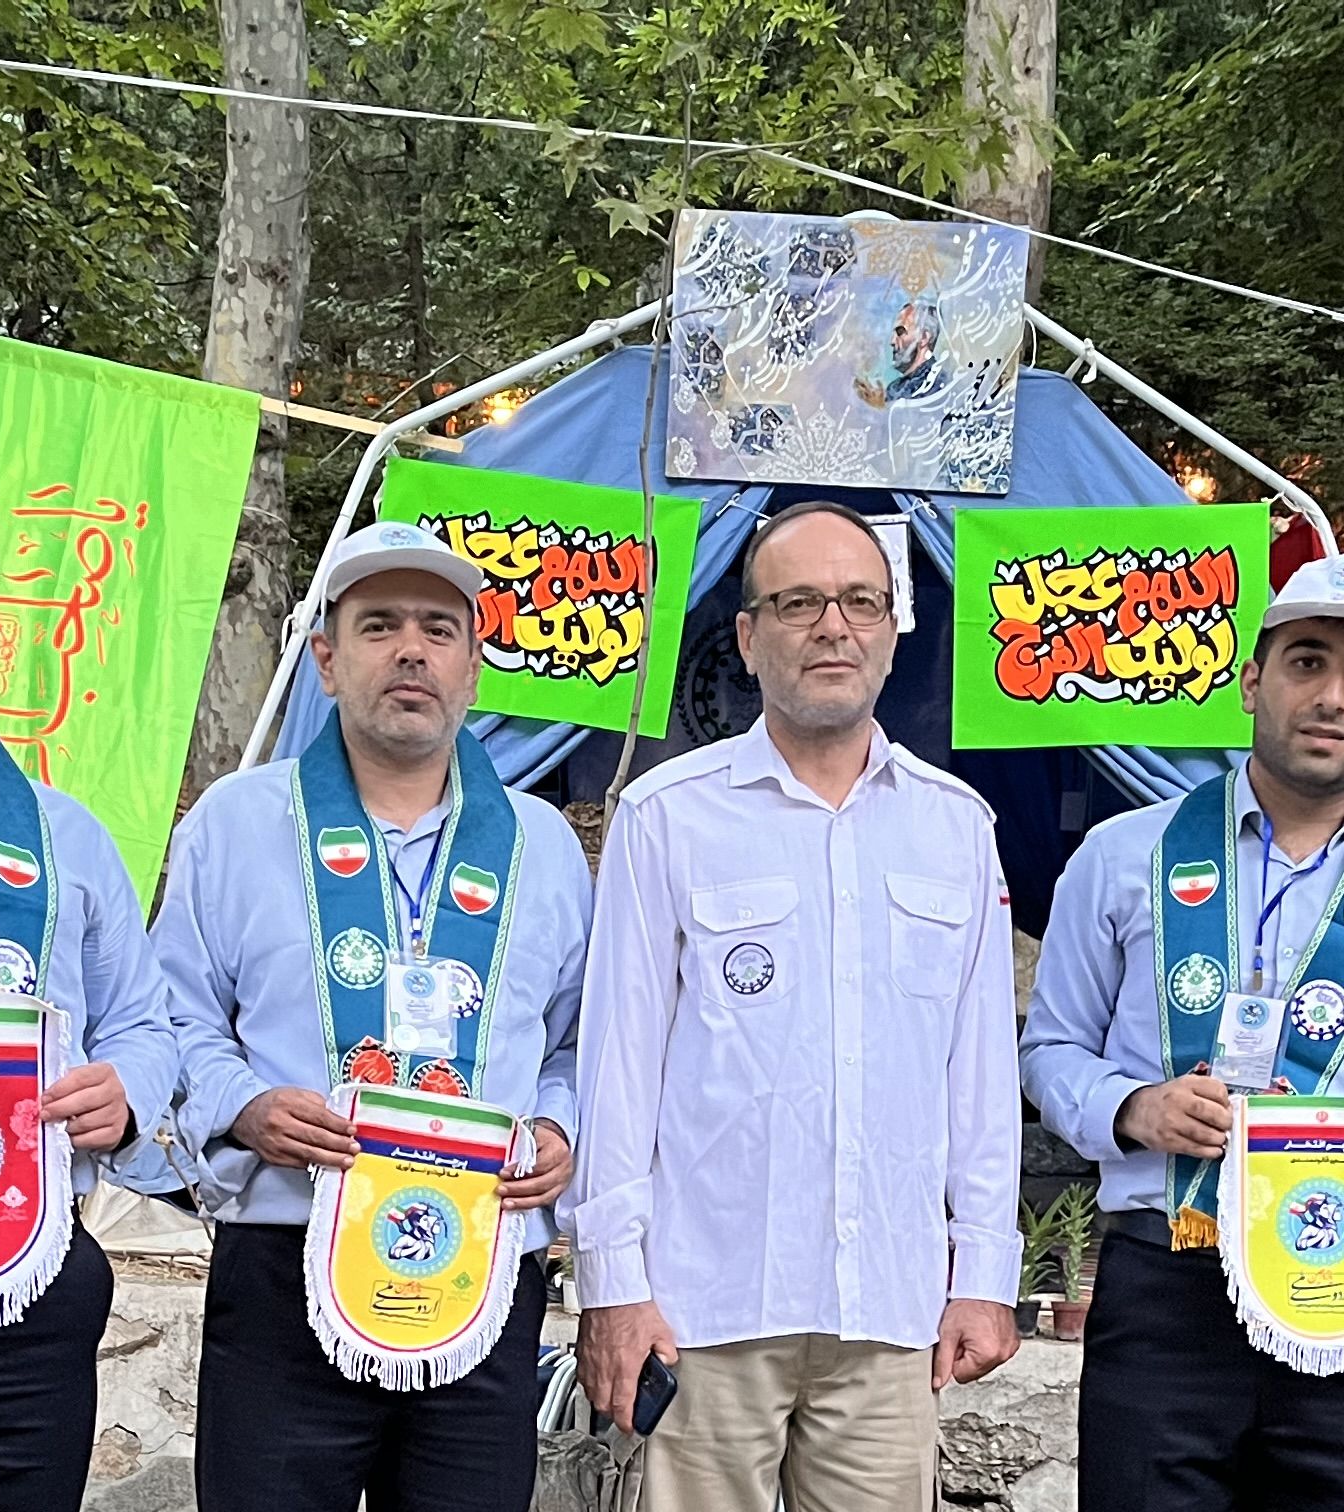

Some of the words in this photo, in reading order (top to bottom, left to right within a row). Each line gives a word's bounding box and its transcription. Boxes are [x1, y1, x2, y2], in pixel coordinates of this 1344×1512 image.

[1118, 550, 1236, 637] اللهم
[993, 620, 1107, 700] الفرج
[391, 1146, 436, 1161] افتخار
[1283, 1139, 1326, 1150] افتخار
